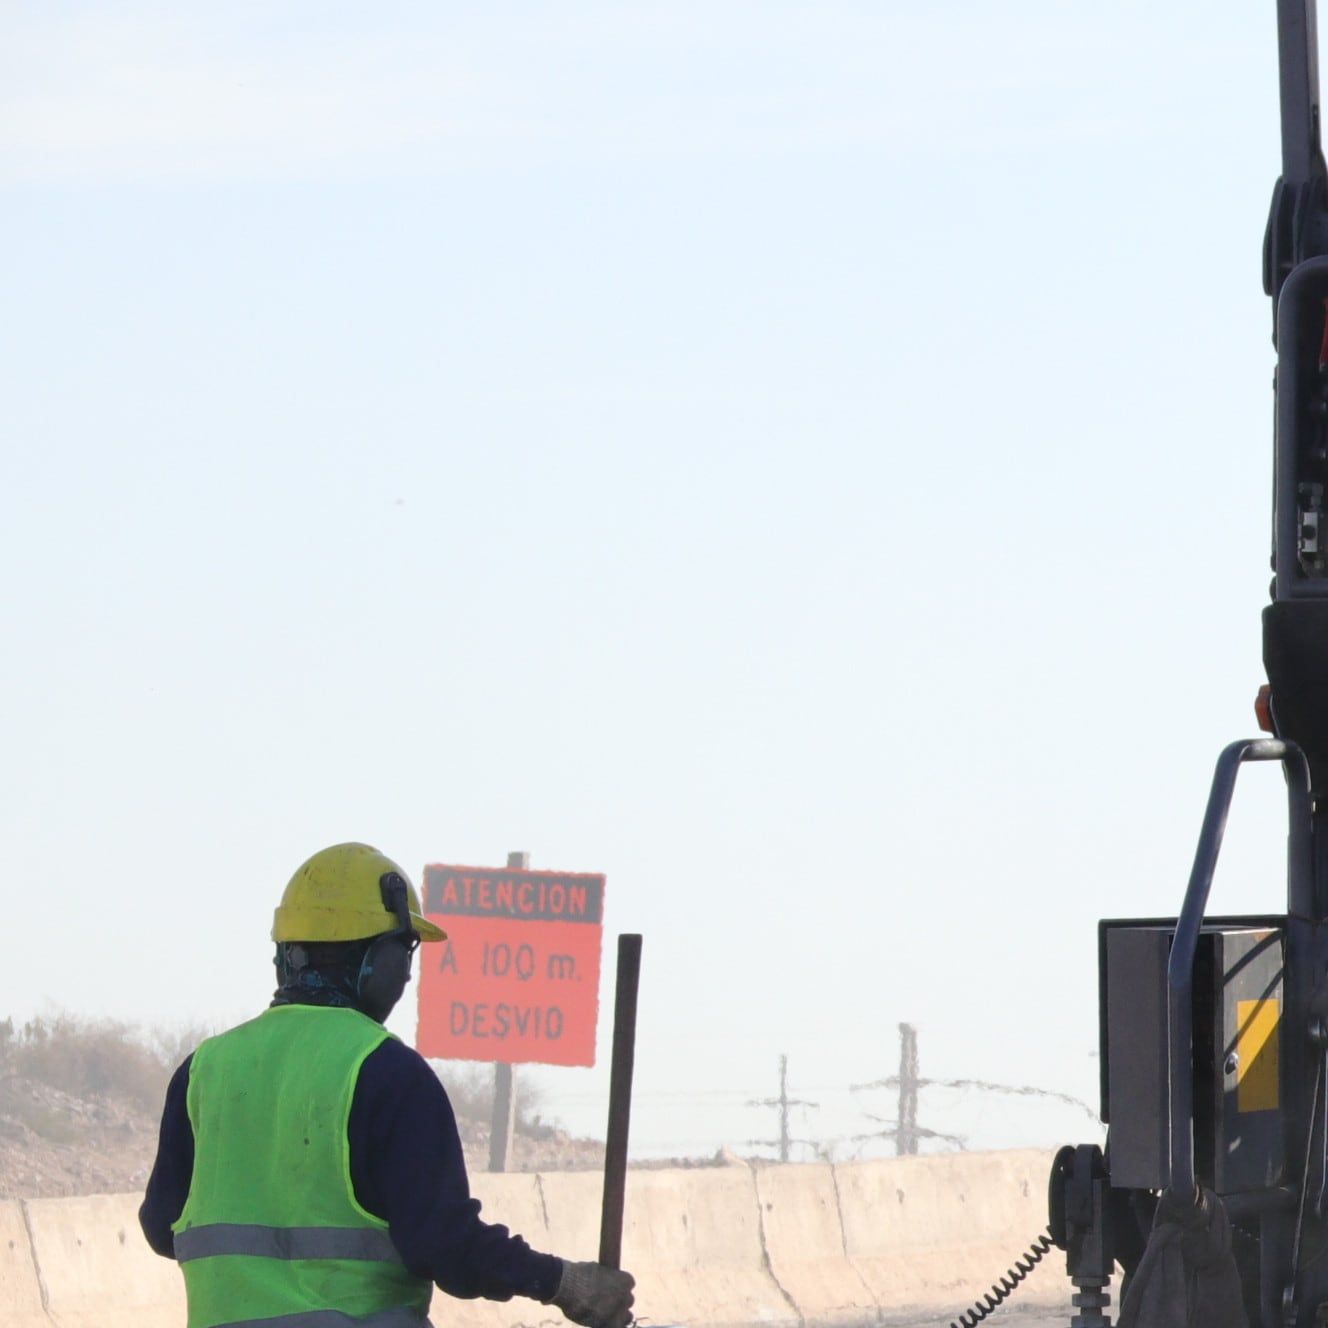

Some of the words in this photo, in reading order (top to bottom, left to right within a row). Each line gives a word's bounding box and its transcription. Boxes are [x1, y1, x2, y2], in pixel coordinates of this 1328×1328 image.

[441, 878, 587, 916] ATENCION
[439, 942, 459, 975] A
[481, 941, 536, 981] 100
[449, 1001, 564, 1041] DESVIO
